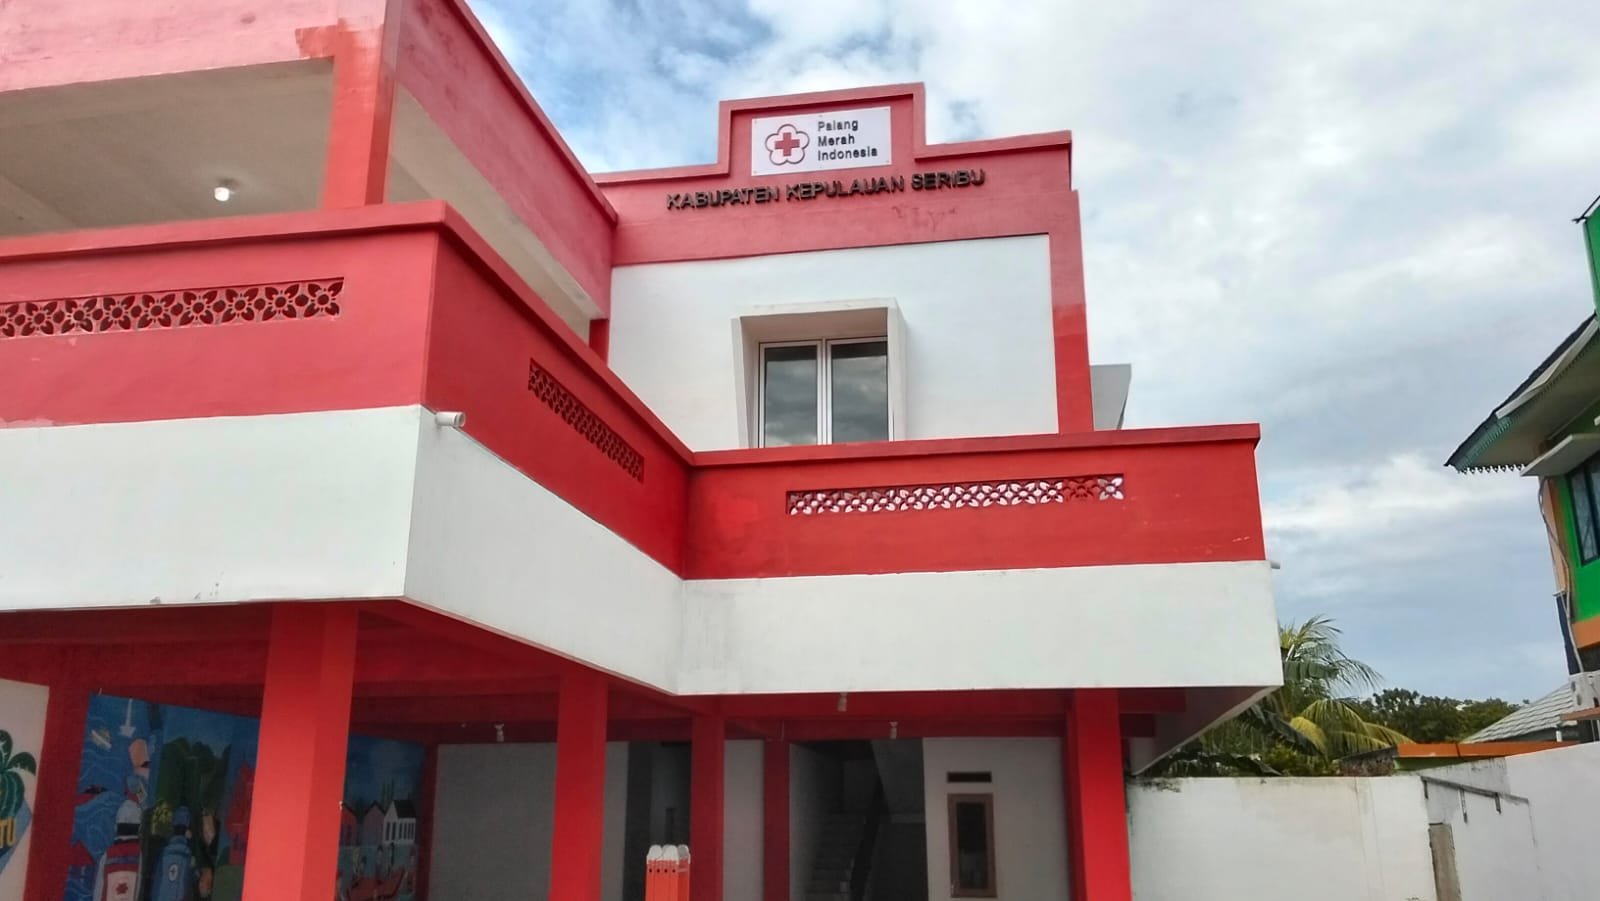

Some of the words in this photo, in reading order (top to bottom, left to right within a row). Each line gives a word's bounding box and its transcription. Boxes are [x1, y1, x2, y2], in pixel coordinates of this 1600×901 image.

[818, 119, 859, 132] Palang
[818, 133, 855, 147] Merah
[818, 145, 878, 161] Indonesia
[667, 185, 780, 210] KABUPATEN
[786, 175, 904, 202] KEPULAUAN
[911, 168, 985, 191] SERIBU
